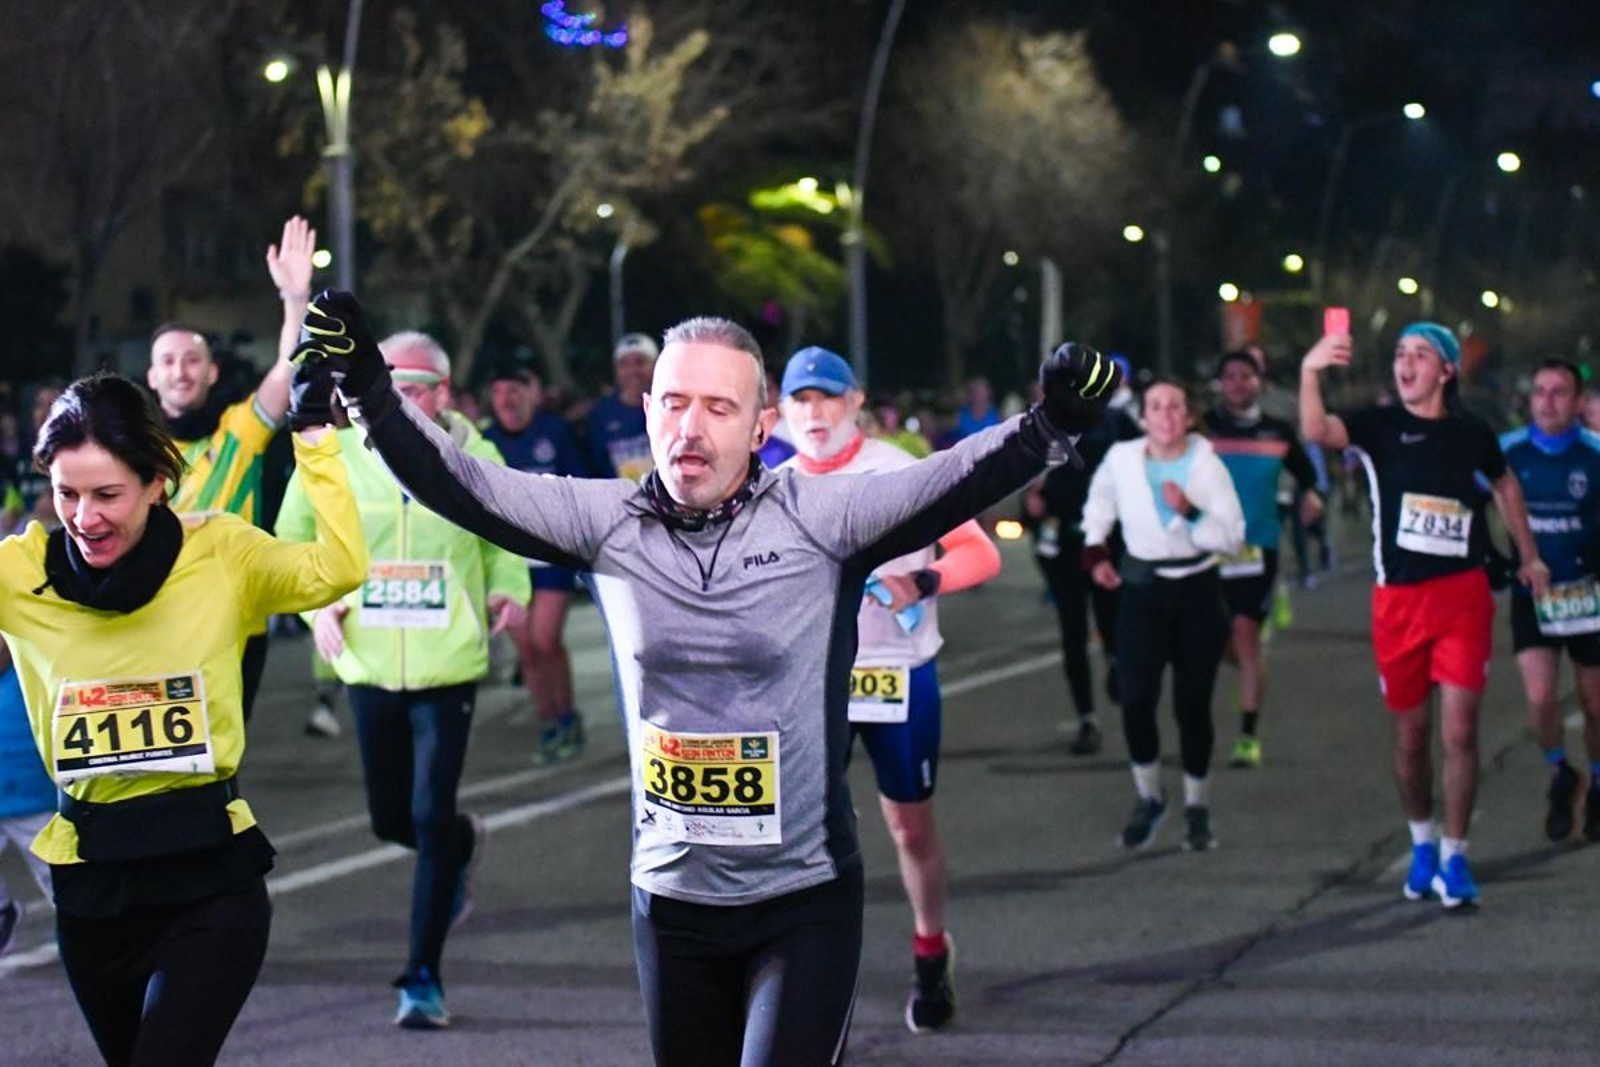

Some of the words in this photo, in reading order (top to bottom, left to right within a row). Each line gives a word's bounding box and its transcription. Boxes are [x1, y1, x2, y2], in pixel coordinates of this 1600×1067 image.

[1409, 510, 1463, 536] 7834
[743, 551, 780, 570] FILA
[366, 580, 443, 604] 2584
[78, 686, 107, 707] 42
[63, 706, 194, 755] 4116
[660, 736, 681, 757] 42
[650, 758, 764, 804] 3858
